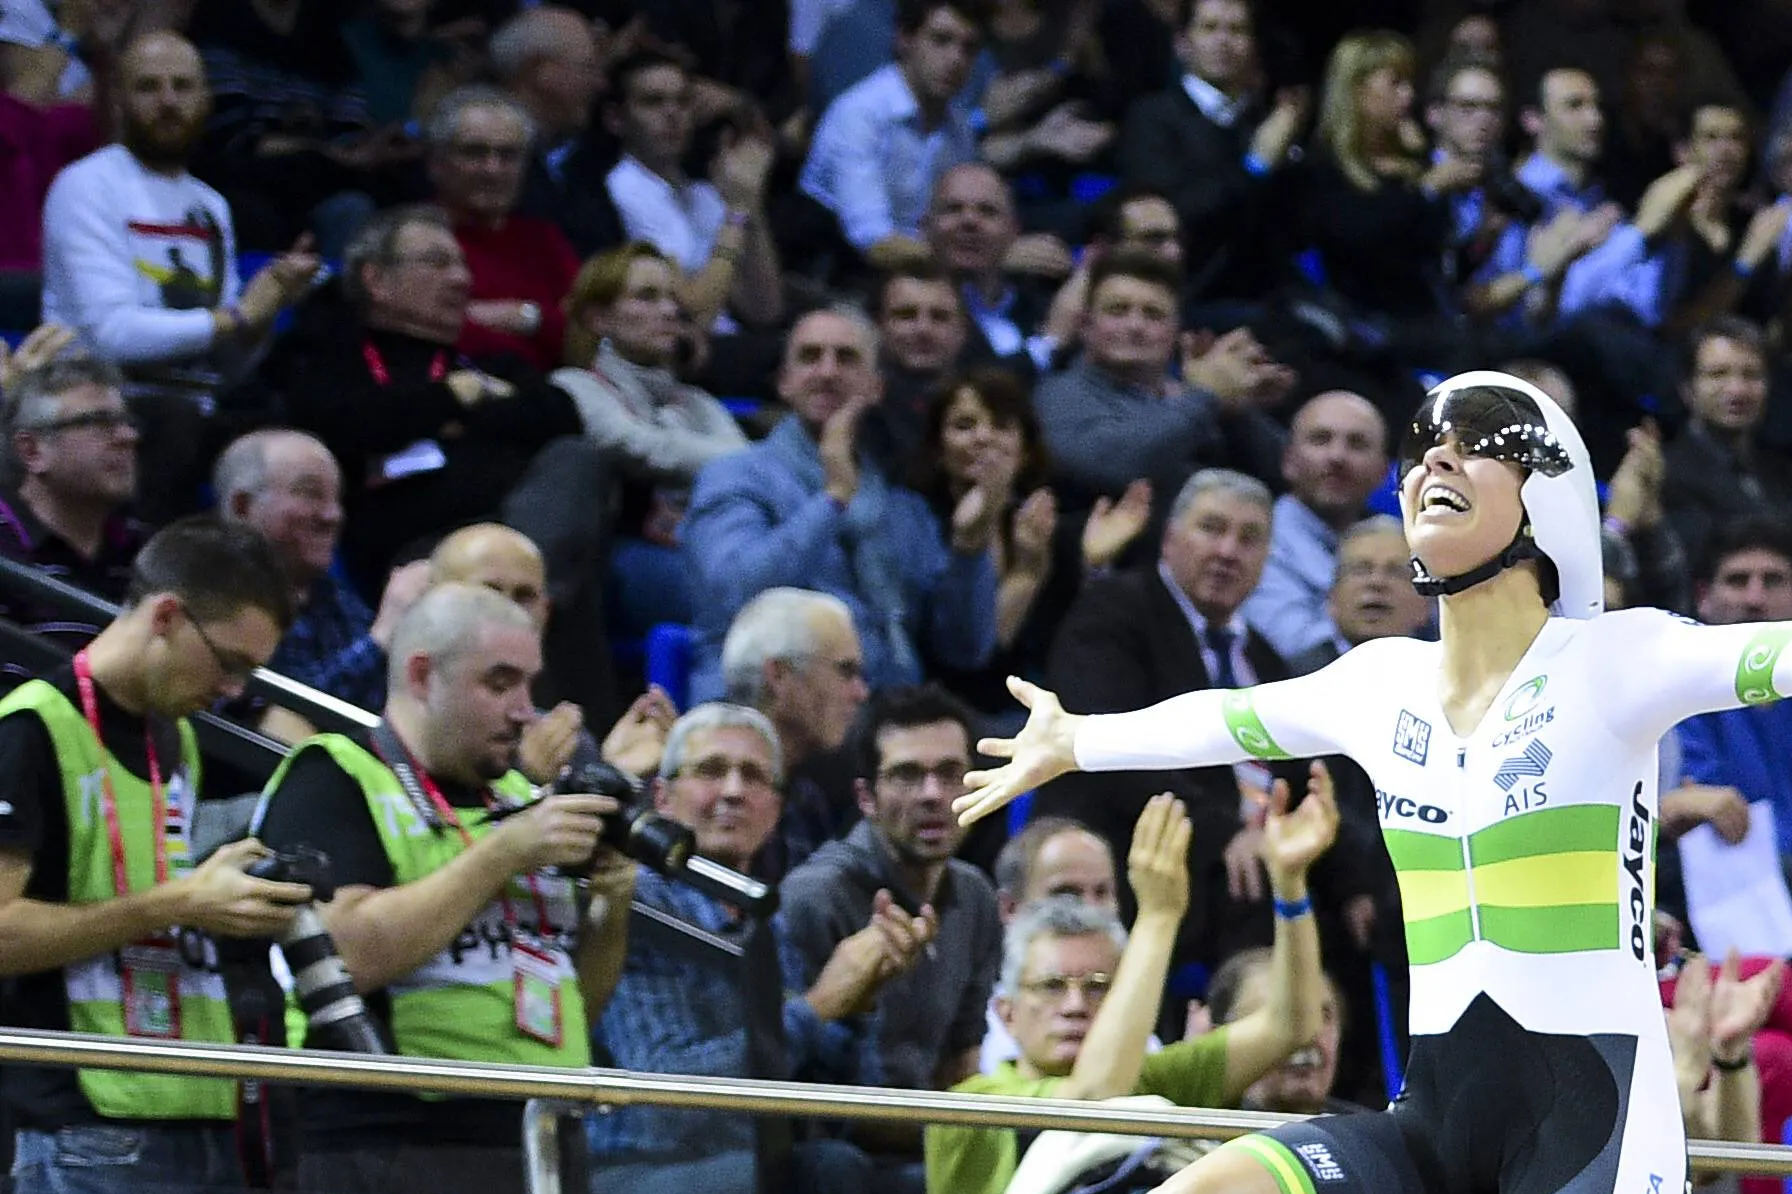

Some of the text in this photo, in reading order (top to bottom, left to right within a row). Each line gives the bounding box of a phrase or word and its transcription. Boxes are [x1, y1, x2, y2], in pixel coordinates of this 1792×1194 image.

[1492, 706, 1555, 747] Cycling
[1375, 787, 1449, 824] ayco
[1504, 781, 1548, 817] AIS
[1623, 780, 1649, 961] Jayco
